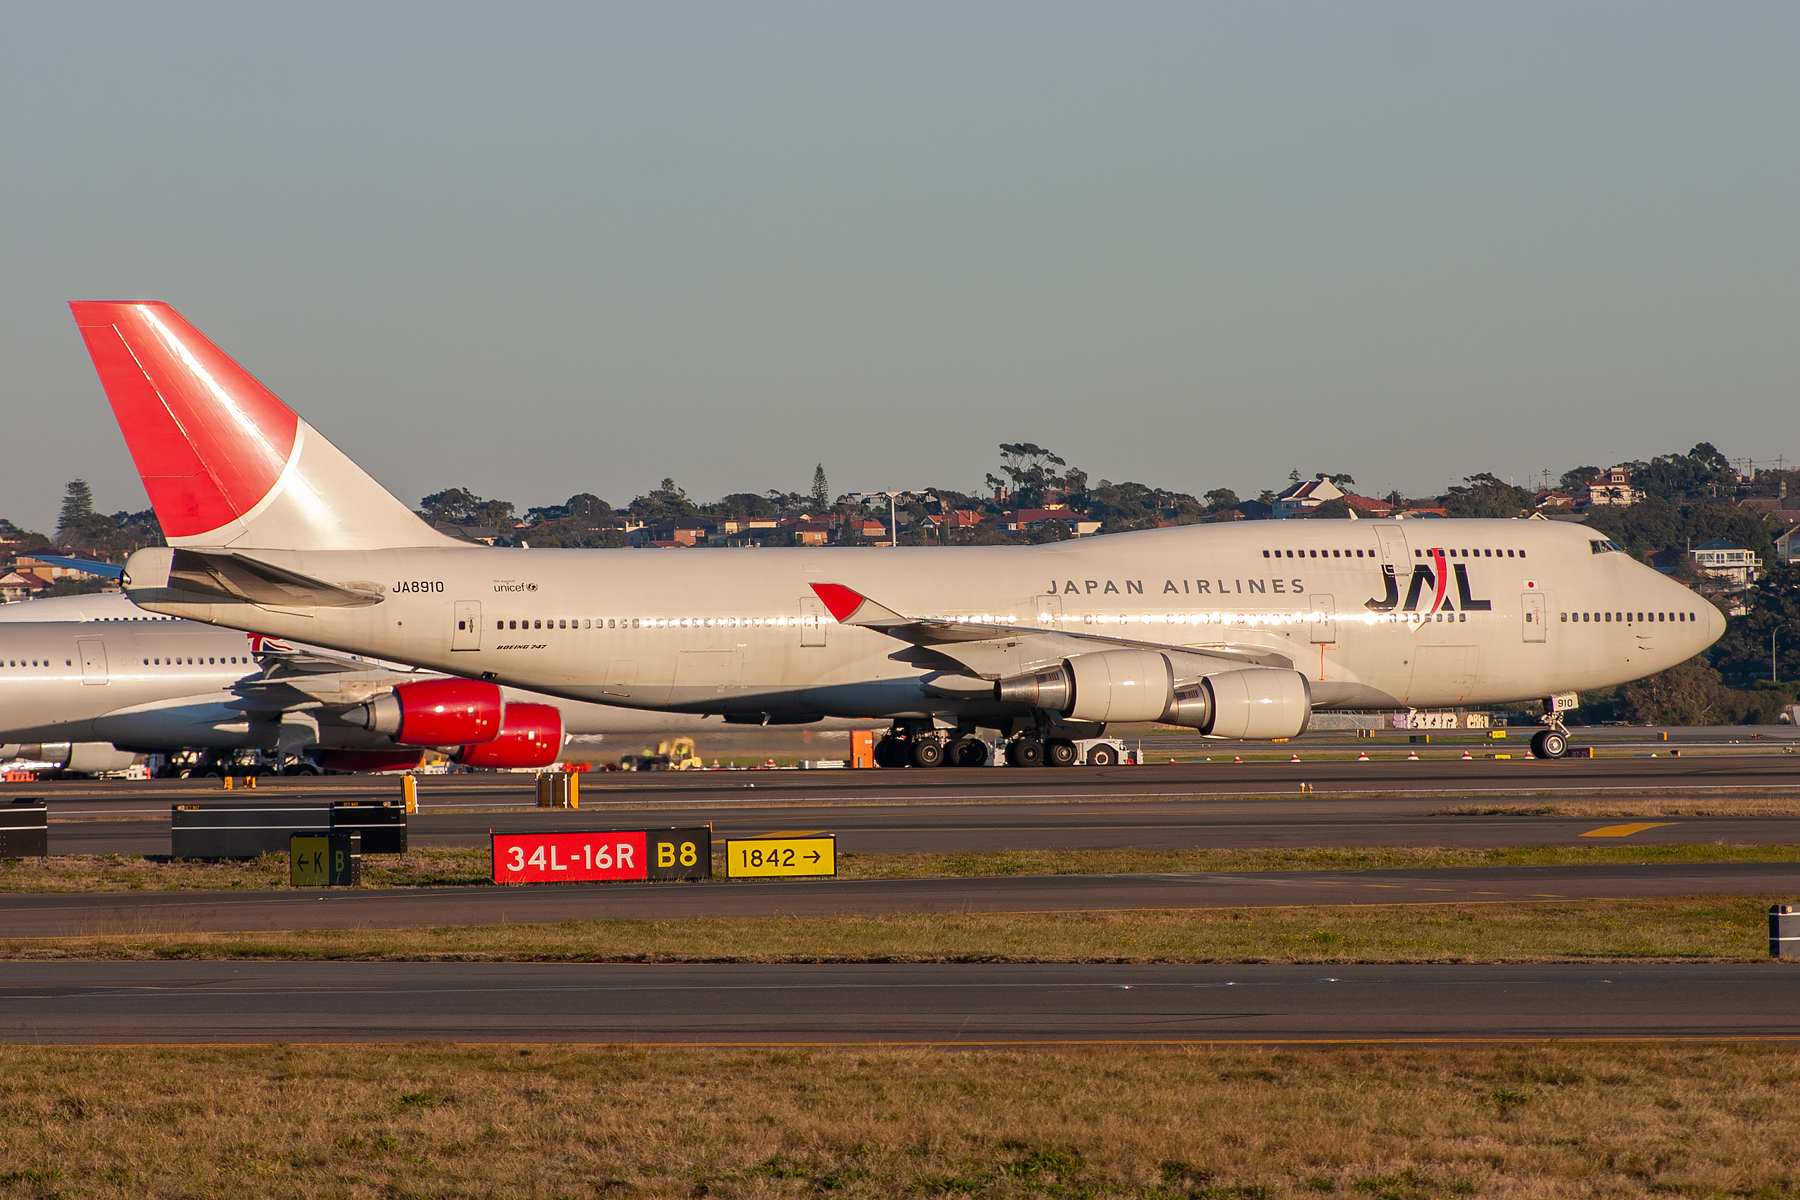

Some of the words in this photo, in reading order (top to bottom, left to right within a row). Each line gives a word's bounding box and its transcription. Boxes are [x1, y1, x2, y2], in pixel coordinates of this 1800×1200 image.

[392, 581, 444, 593] JA8910
[494, 583, 525, 592] unicef
[1047, 579, 1143, 595] JAPAN
[1163, 578, 1305, 595] AIRLINES
[1364, 548, 1492, 626] JAL
[1558, 699, 1573, 707] 910
[314, 851, 323, 873] K
[335, 850, 344, 872] B
[506, 843, 635, 872] 34L-16R
[657, 841, 698, 868] B8
[741, 848, 795, 868] 1842
